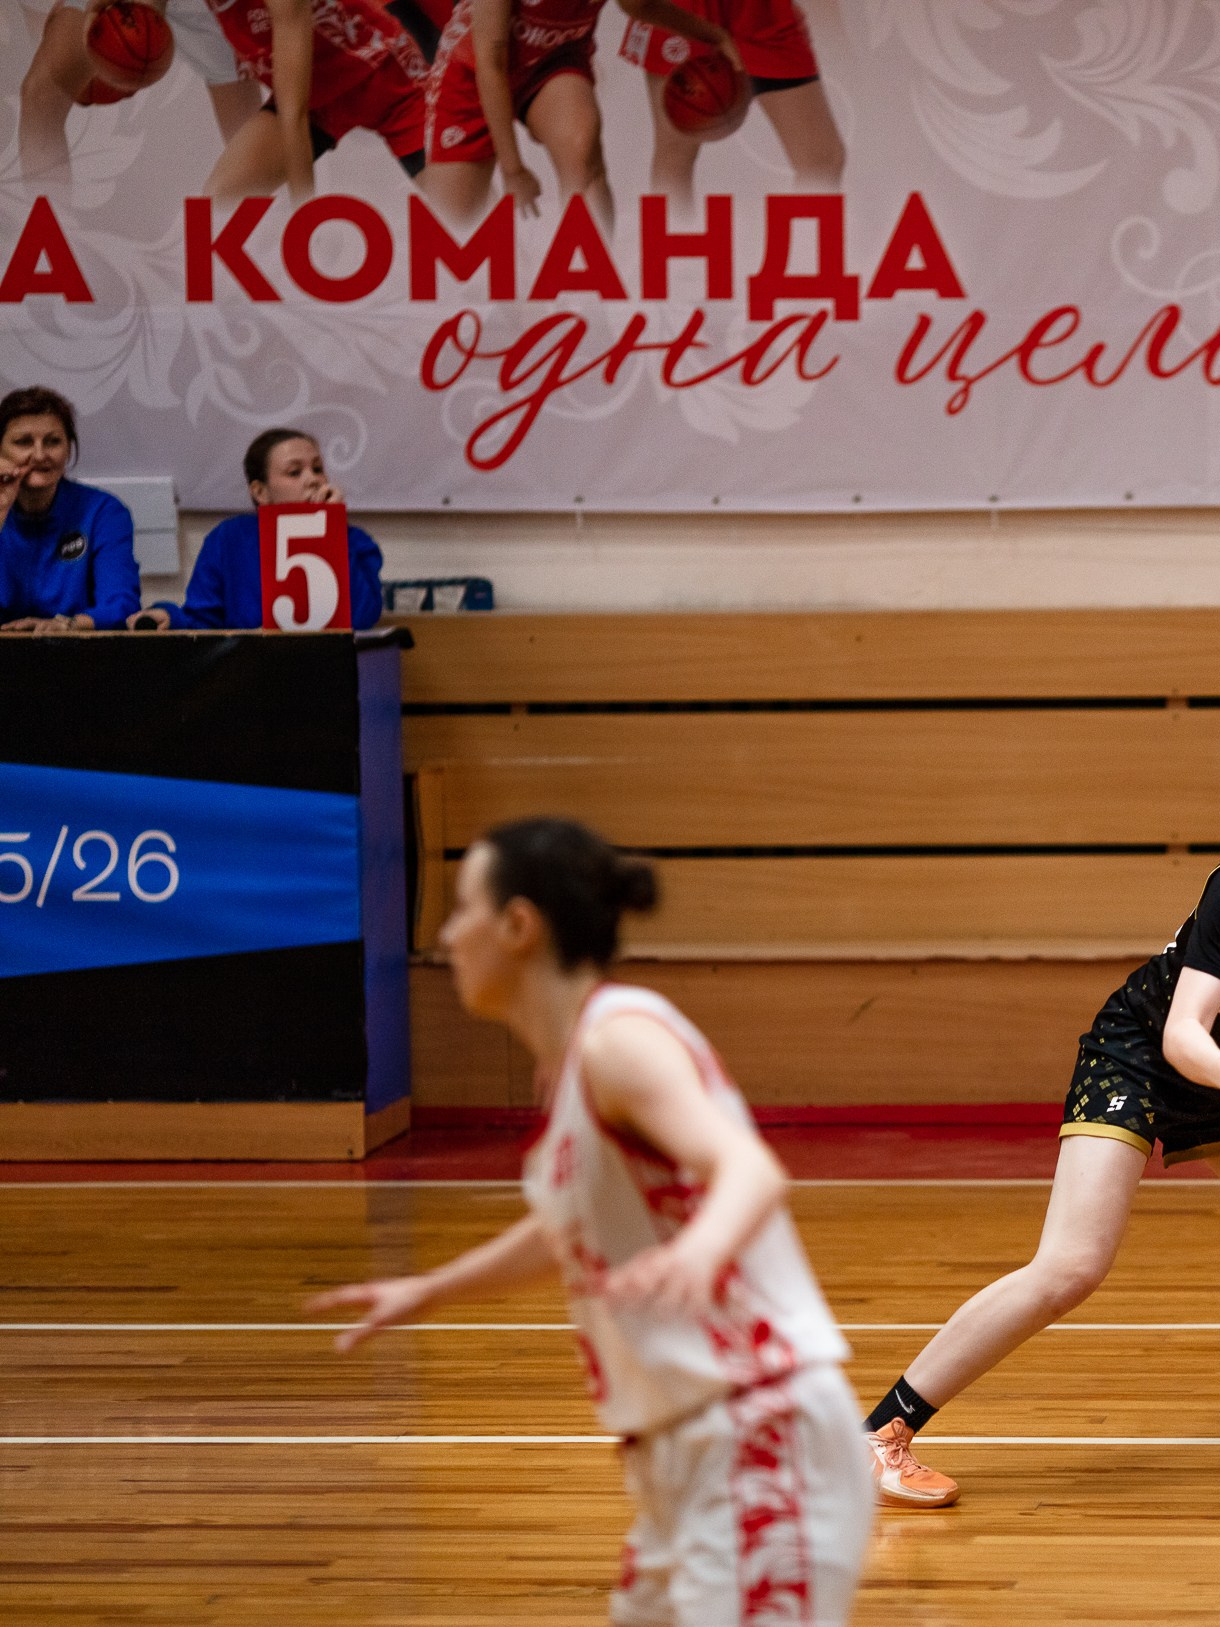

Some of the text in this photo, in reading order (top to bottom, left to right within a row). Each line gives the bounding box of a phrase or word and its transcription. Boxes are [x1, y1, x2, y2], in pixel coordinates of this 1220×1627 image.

[184, 192, 967, 322] КОМАНДА
[420, 307, 839, 471] одна
[272, 510, 340, 632] 5
